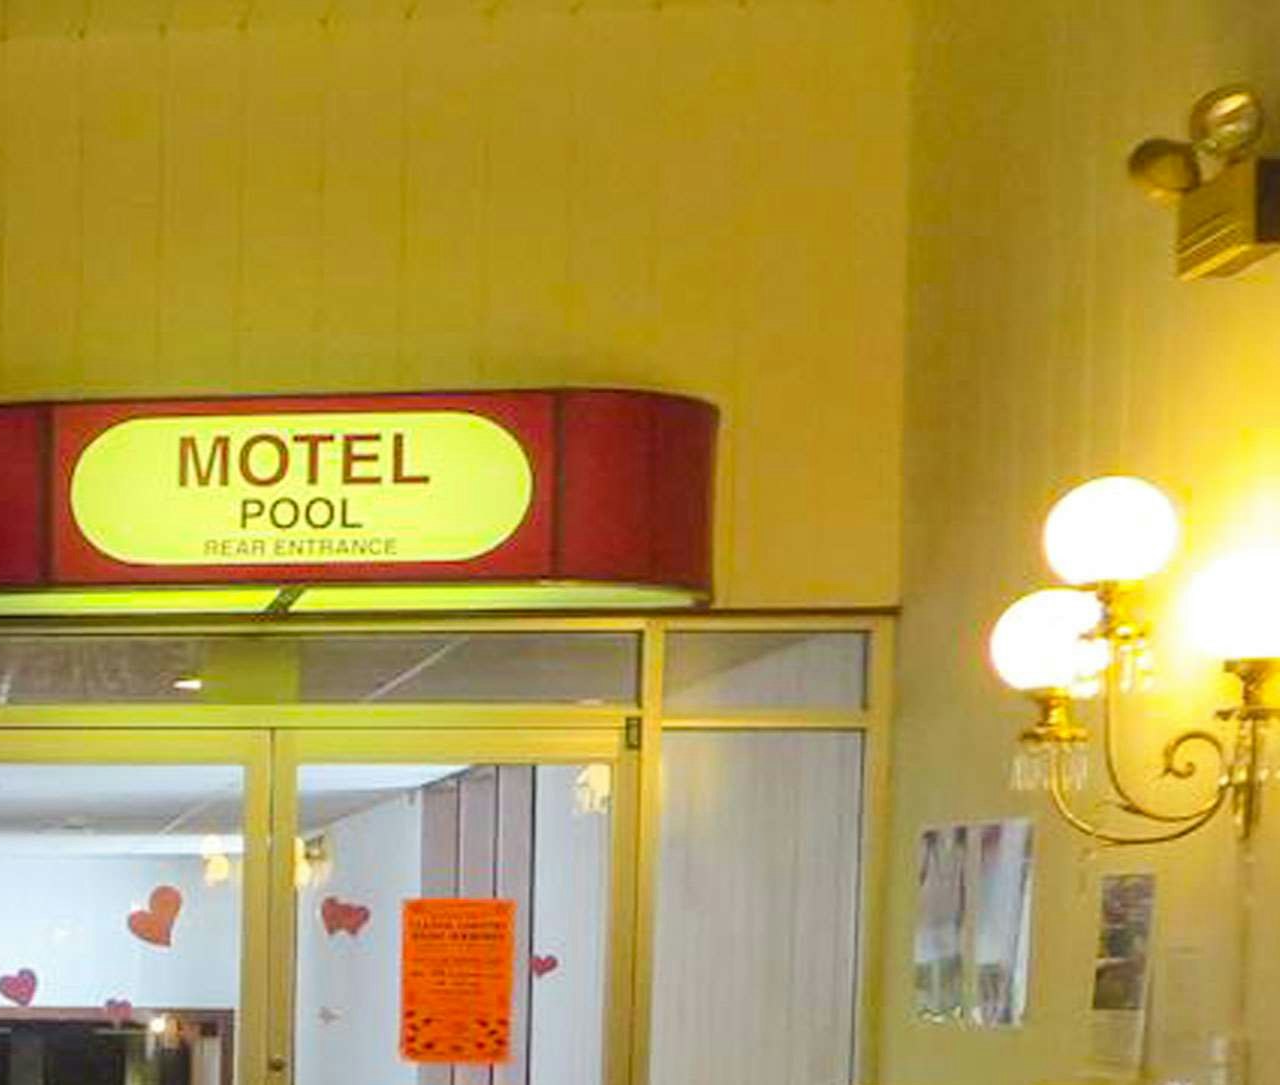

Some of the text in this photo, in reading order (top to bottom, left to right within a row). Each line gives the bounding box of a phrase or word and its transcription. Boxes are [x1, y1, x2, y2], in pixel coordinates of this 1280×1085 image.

[178, 433, 431, 487] MOTEL
[239, 497, 363, 529] POOL
[203, 537, 398, 556] REAR ENTRANCE
